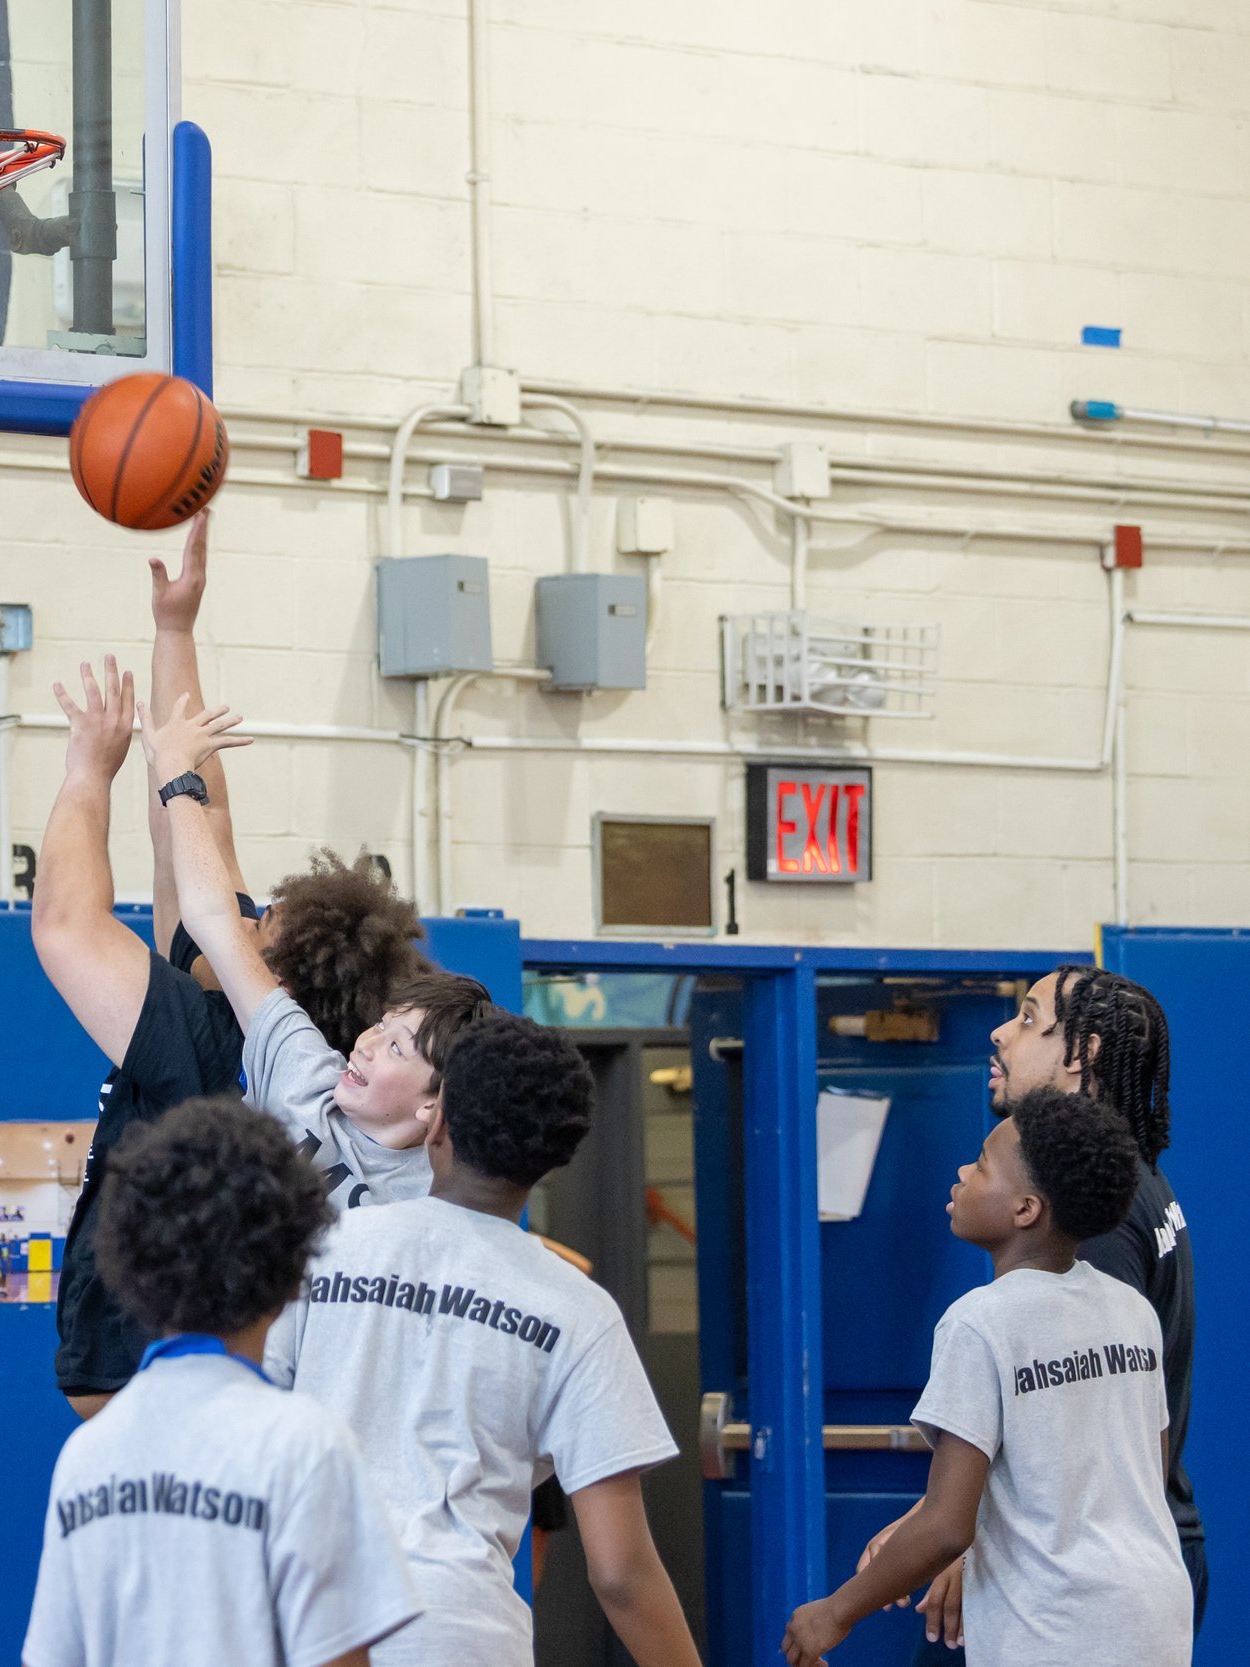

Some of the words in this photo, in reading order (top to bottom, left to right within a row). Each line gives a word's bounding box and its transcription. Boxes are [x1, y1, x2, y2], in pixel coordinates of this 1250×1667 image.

[777, 781, 865, 874] EXIT
[724, 868, 739, 935] 1
[310, 1271, 436, 1315] ahsaiah
[437, 1283, 562, 1353] Watson
[151, 1470, 267, 1531] Watson
